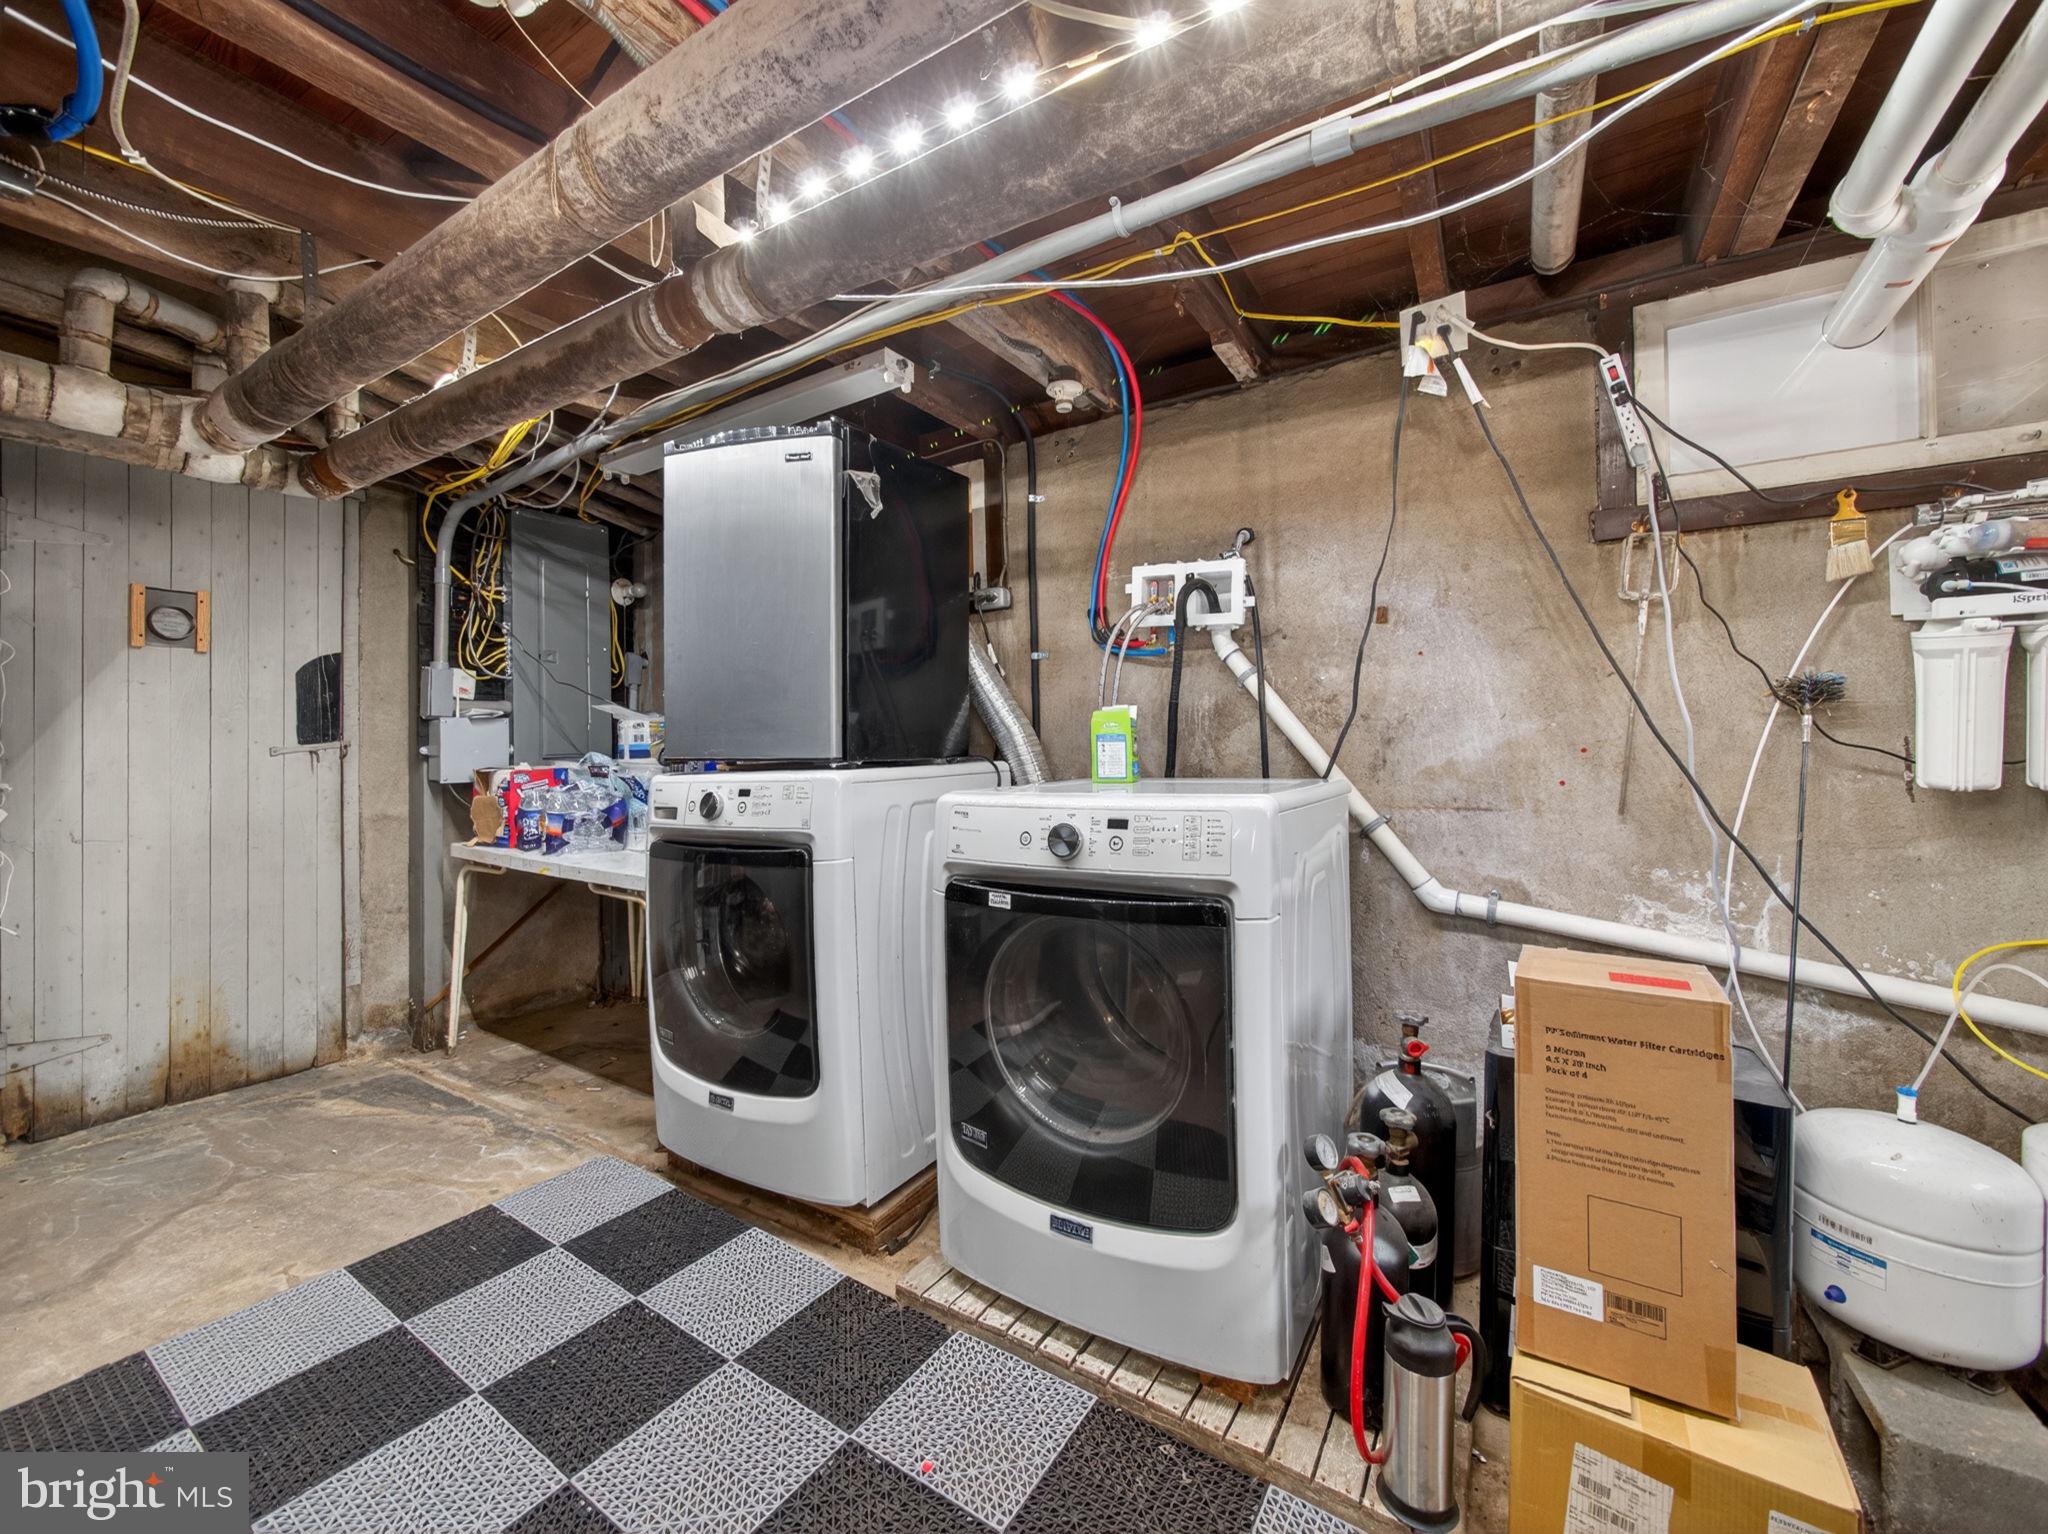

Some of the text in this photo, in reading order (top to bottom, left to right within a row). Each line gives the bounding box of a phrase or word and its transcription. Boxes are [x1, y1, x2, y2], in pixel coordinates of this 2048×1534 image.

[1553, 1046, 1586, 1059] Micron
[1607, 1036, 1638, 1048] Water
[1639, 1041, 1666, 1053] Filter
[1668, 1045, 1726, 1062] Cartridges
[1545, 1065, 1588, 1080] Pack of 4
